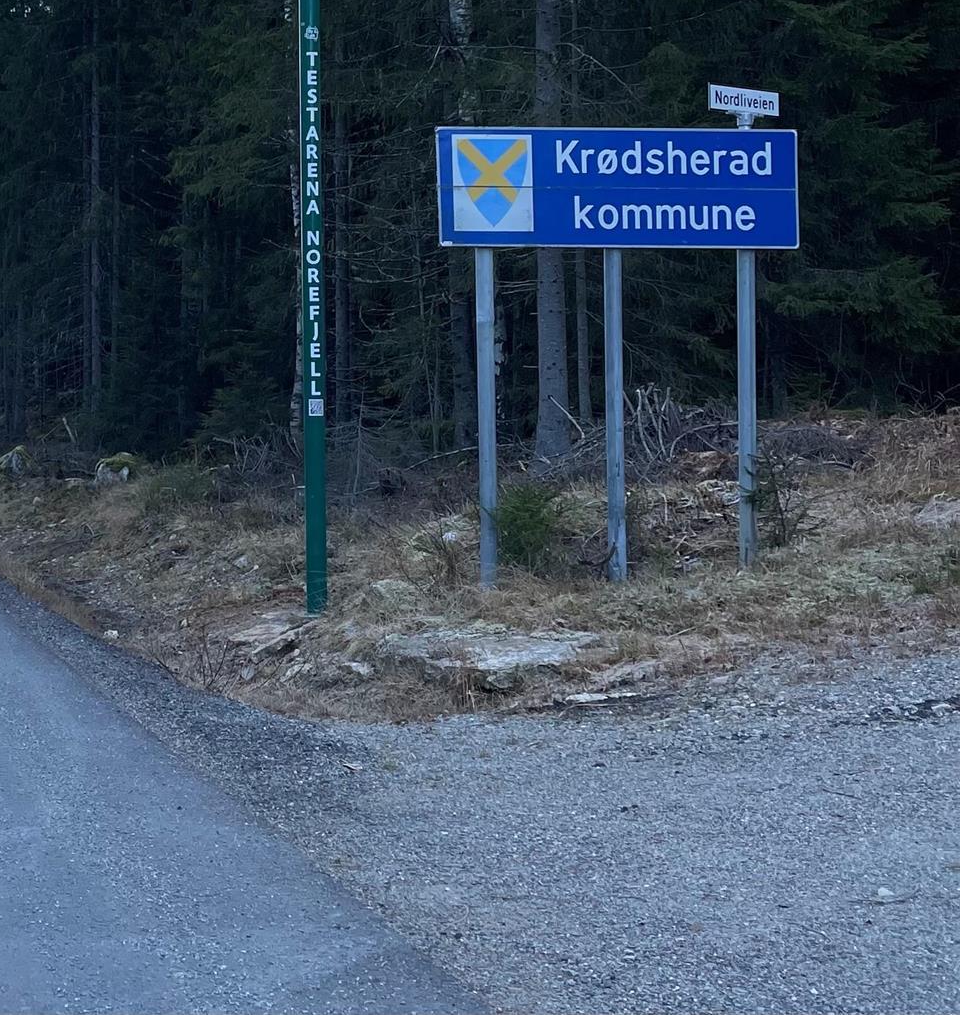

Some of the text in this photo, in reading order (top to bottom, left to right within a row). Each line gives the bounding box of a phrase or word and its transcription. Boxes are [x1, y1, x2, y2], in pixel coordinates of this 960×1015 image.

[714, 89, 775, 111] Nordliveien
[555, 139, 773, 176] Krødsherad
[305, 51, 322, 396] TESTARENA NOREFJELL
[573, 195, 757, 232] kommune
